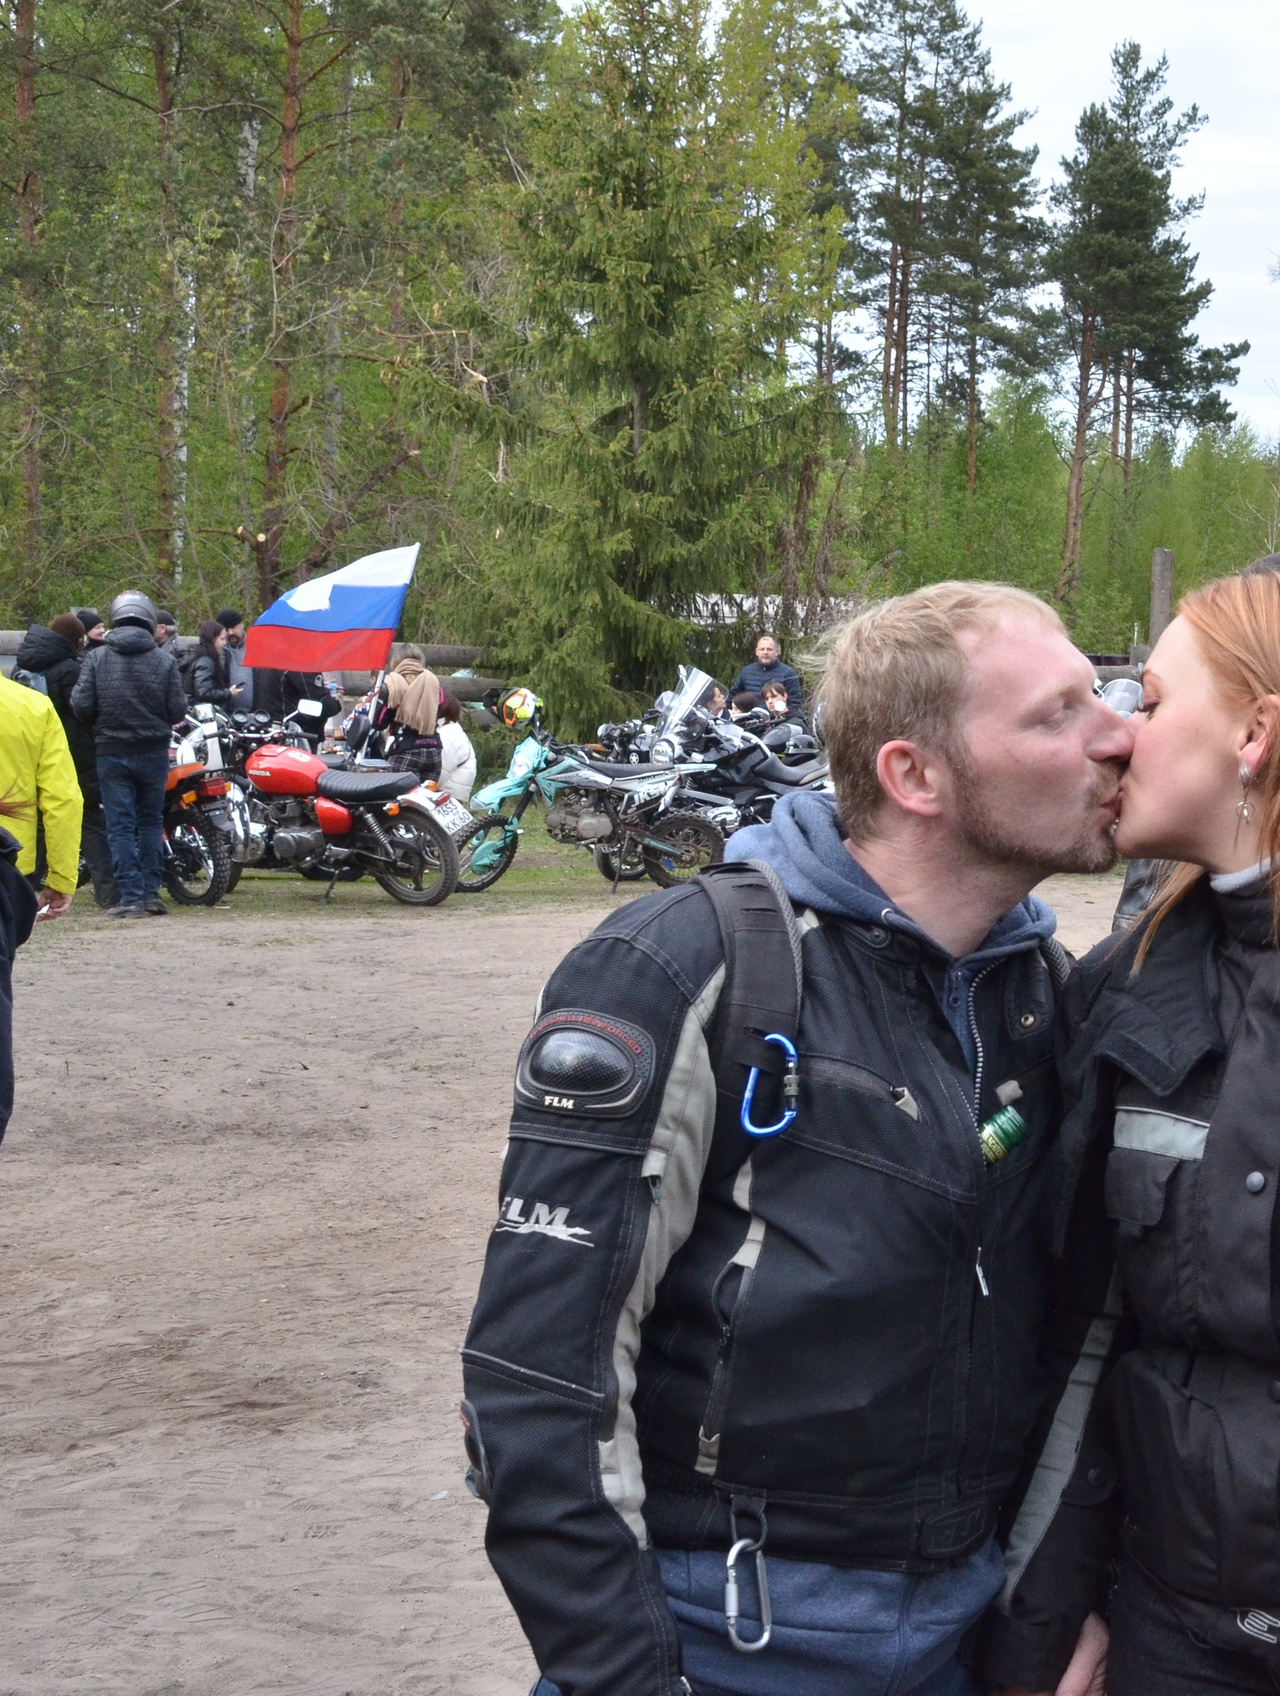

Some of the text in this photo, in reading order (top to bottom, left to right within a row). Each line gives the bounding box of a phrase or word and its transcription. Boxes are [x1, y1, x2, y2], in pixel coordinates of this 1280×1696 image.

[437, 800, 458, 818] 1653
[579, 1015, 643, 1055] REINFORCED
[543, 1095, 575, 1109] FLM
